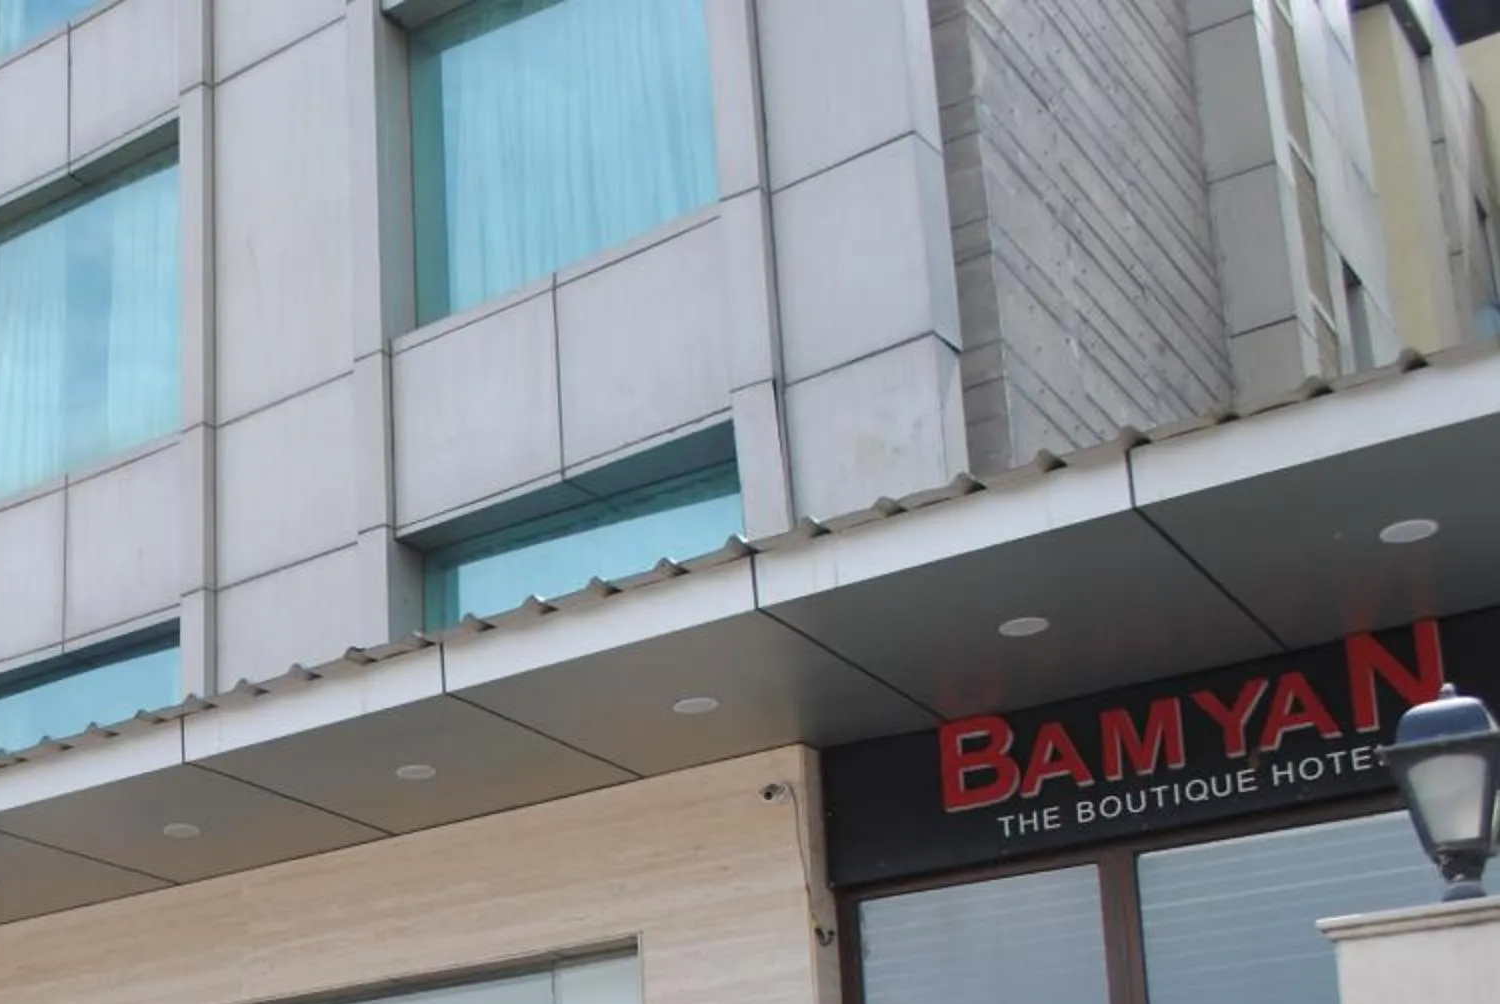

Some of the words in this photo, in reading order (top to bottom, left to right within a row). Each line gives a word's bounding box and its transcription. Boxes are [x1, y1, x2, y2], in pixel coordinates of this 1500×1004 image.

[937, 619, 1444, 812] BAMYAN
[997, 807, 1061, 838] THE
[1076, 770, 1256, 824] BOUTIQUE
